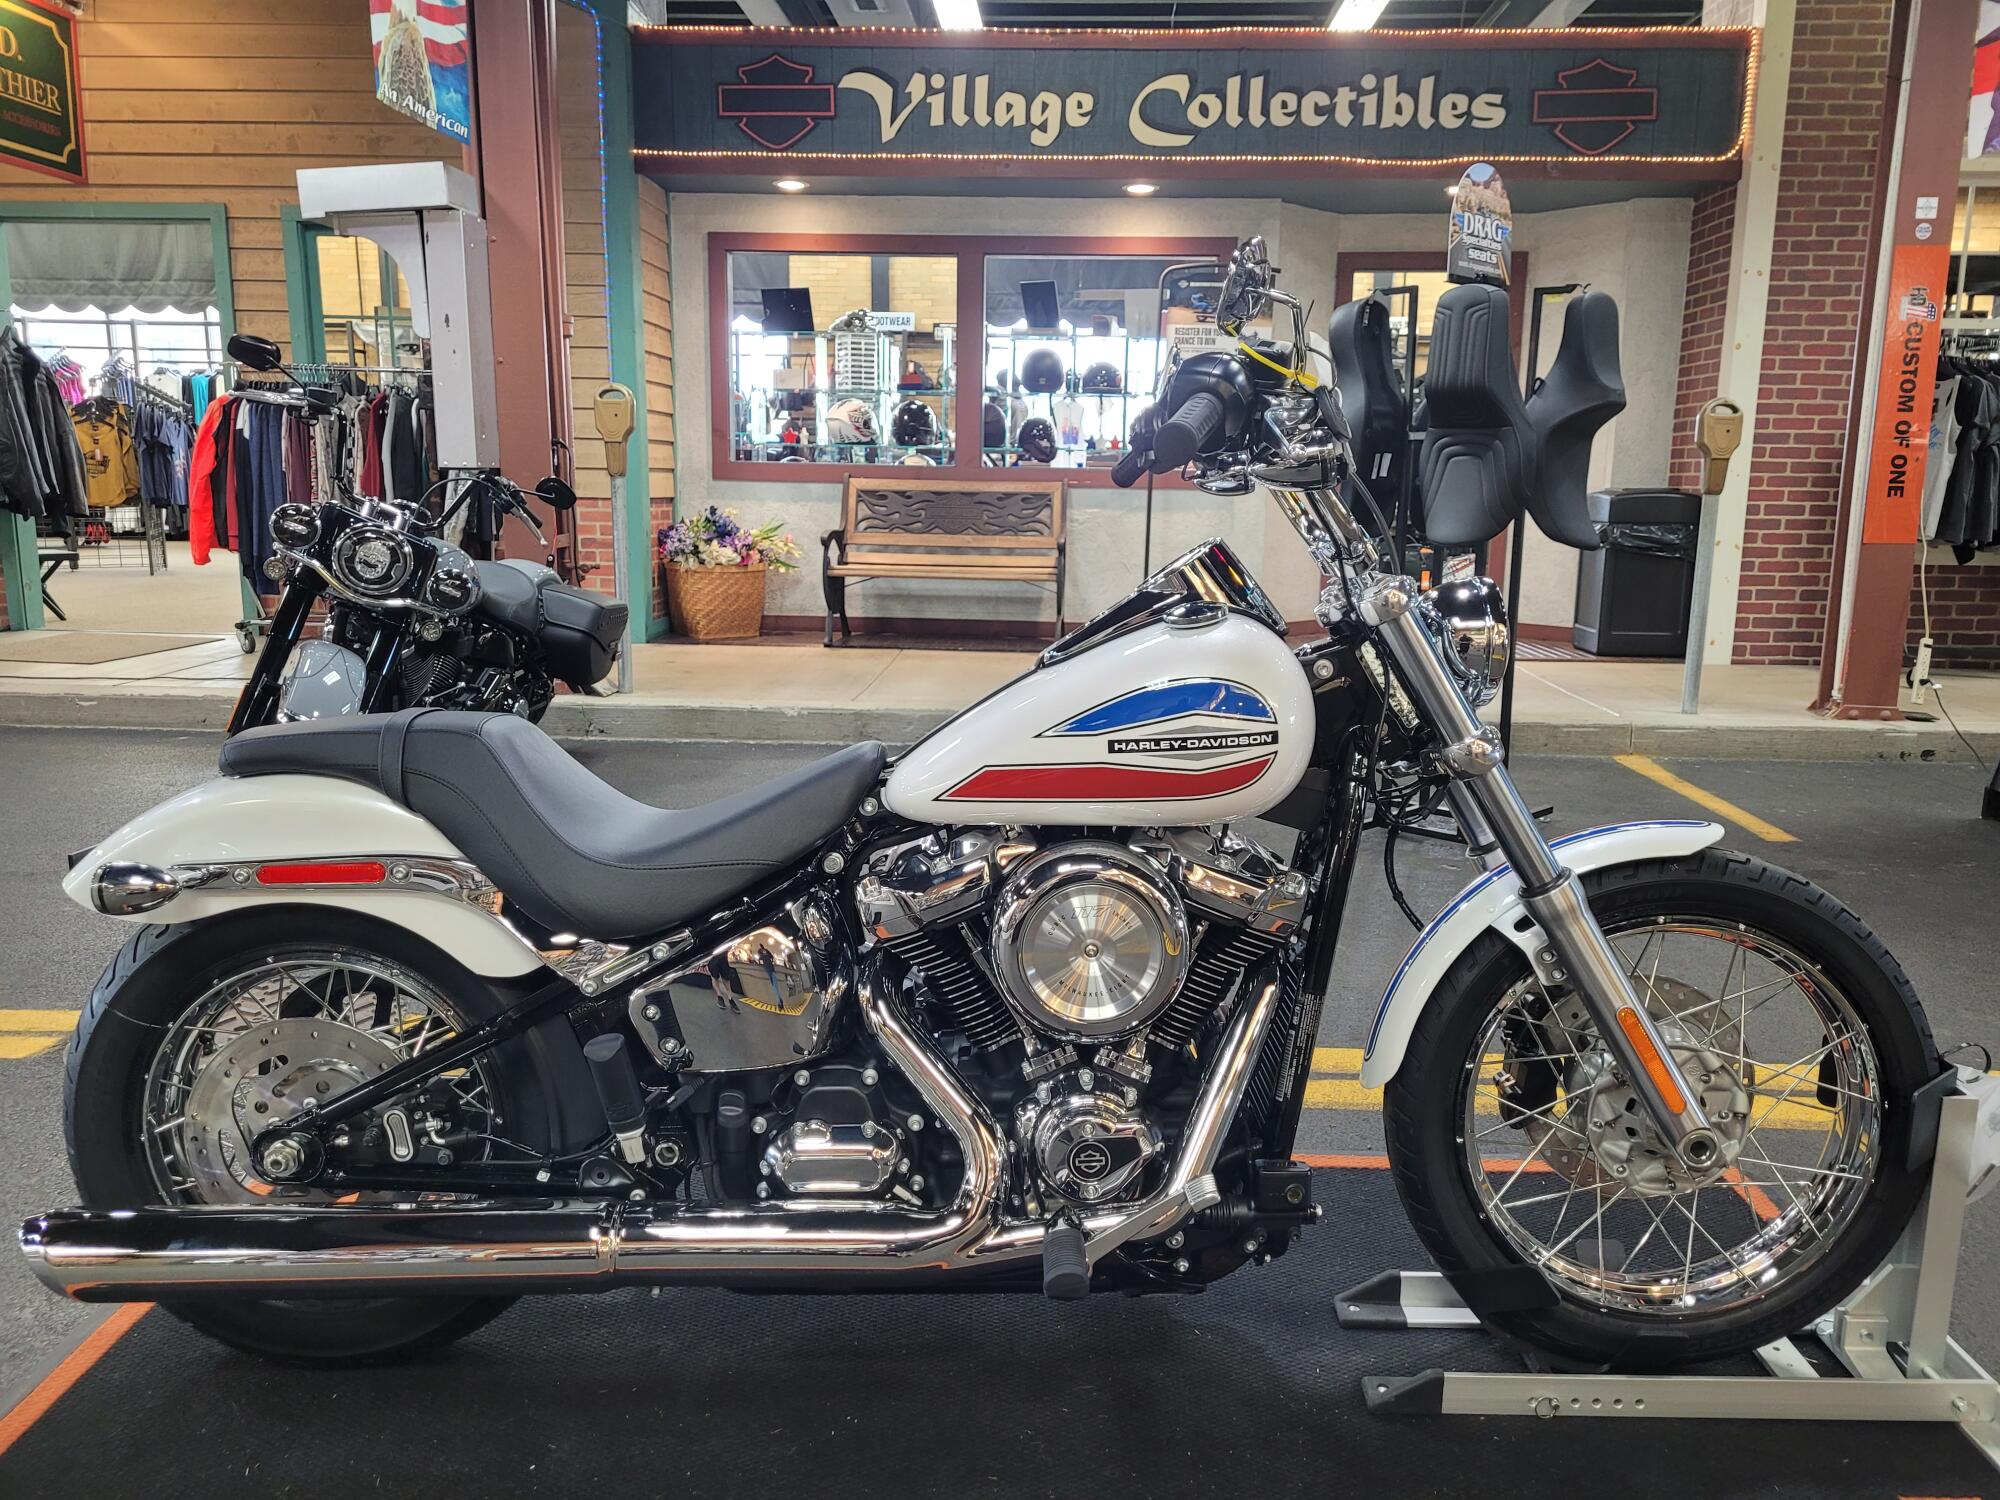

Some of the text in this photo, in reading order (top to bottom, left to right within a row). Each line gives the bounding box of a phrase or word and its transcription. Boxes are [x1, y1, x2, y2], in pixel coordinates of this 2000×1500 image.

[380, 82, 468, 138] An American
[837, 71, 1507, 147] Village Collectibles
[1463, 211, 1504, 243] DRAG
[1468, 248, 1498, 264] seats
[1887, 321, 1924, 498] CUSTOM OF ONE
[1113, 733, 1274, 752] HARLEY-DAVIDSON
